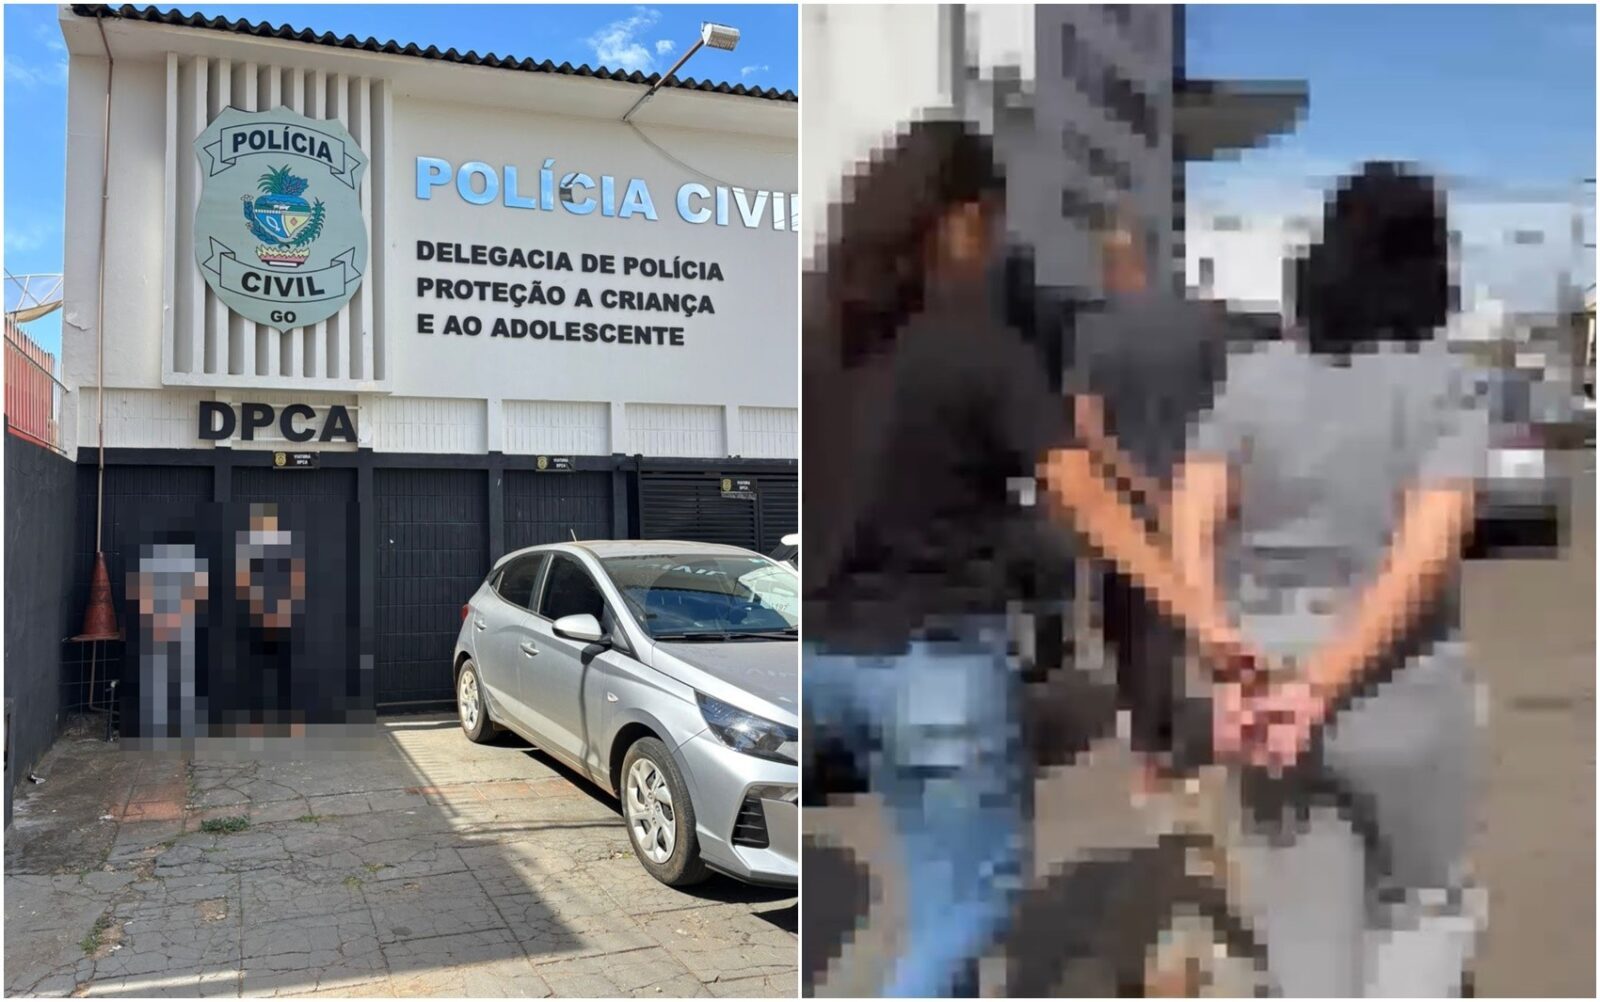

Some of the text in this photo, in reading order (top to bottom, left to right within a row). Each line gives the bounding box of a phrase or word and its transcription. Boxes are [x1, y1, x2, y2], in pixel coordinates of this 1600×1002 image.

[232, 126, 333, 163] POLÍCIA
[415, 156, 658, 220] POLÍCIA
[416, 240, 724, 282] DELEGACIA DE POLÍCIA
[241, 271, 325, 297] CIVIL
[417, 277, 715, 317] PROTEÇÃO A CRIANÇA
[270, 310, 297, 323] GO
[417, 313, 685, 347] E AO ADOLESCENTE
[198, 400, 359, 443] DPCA
